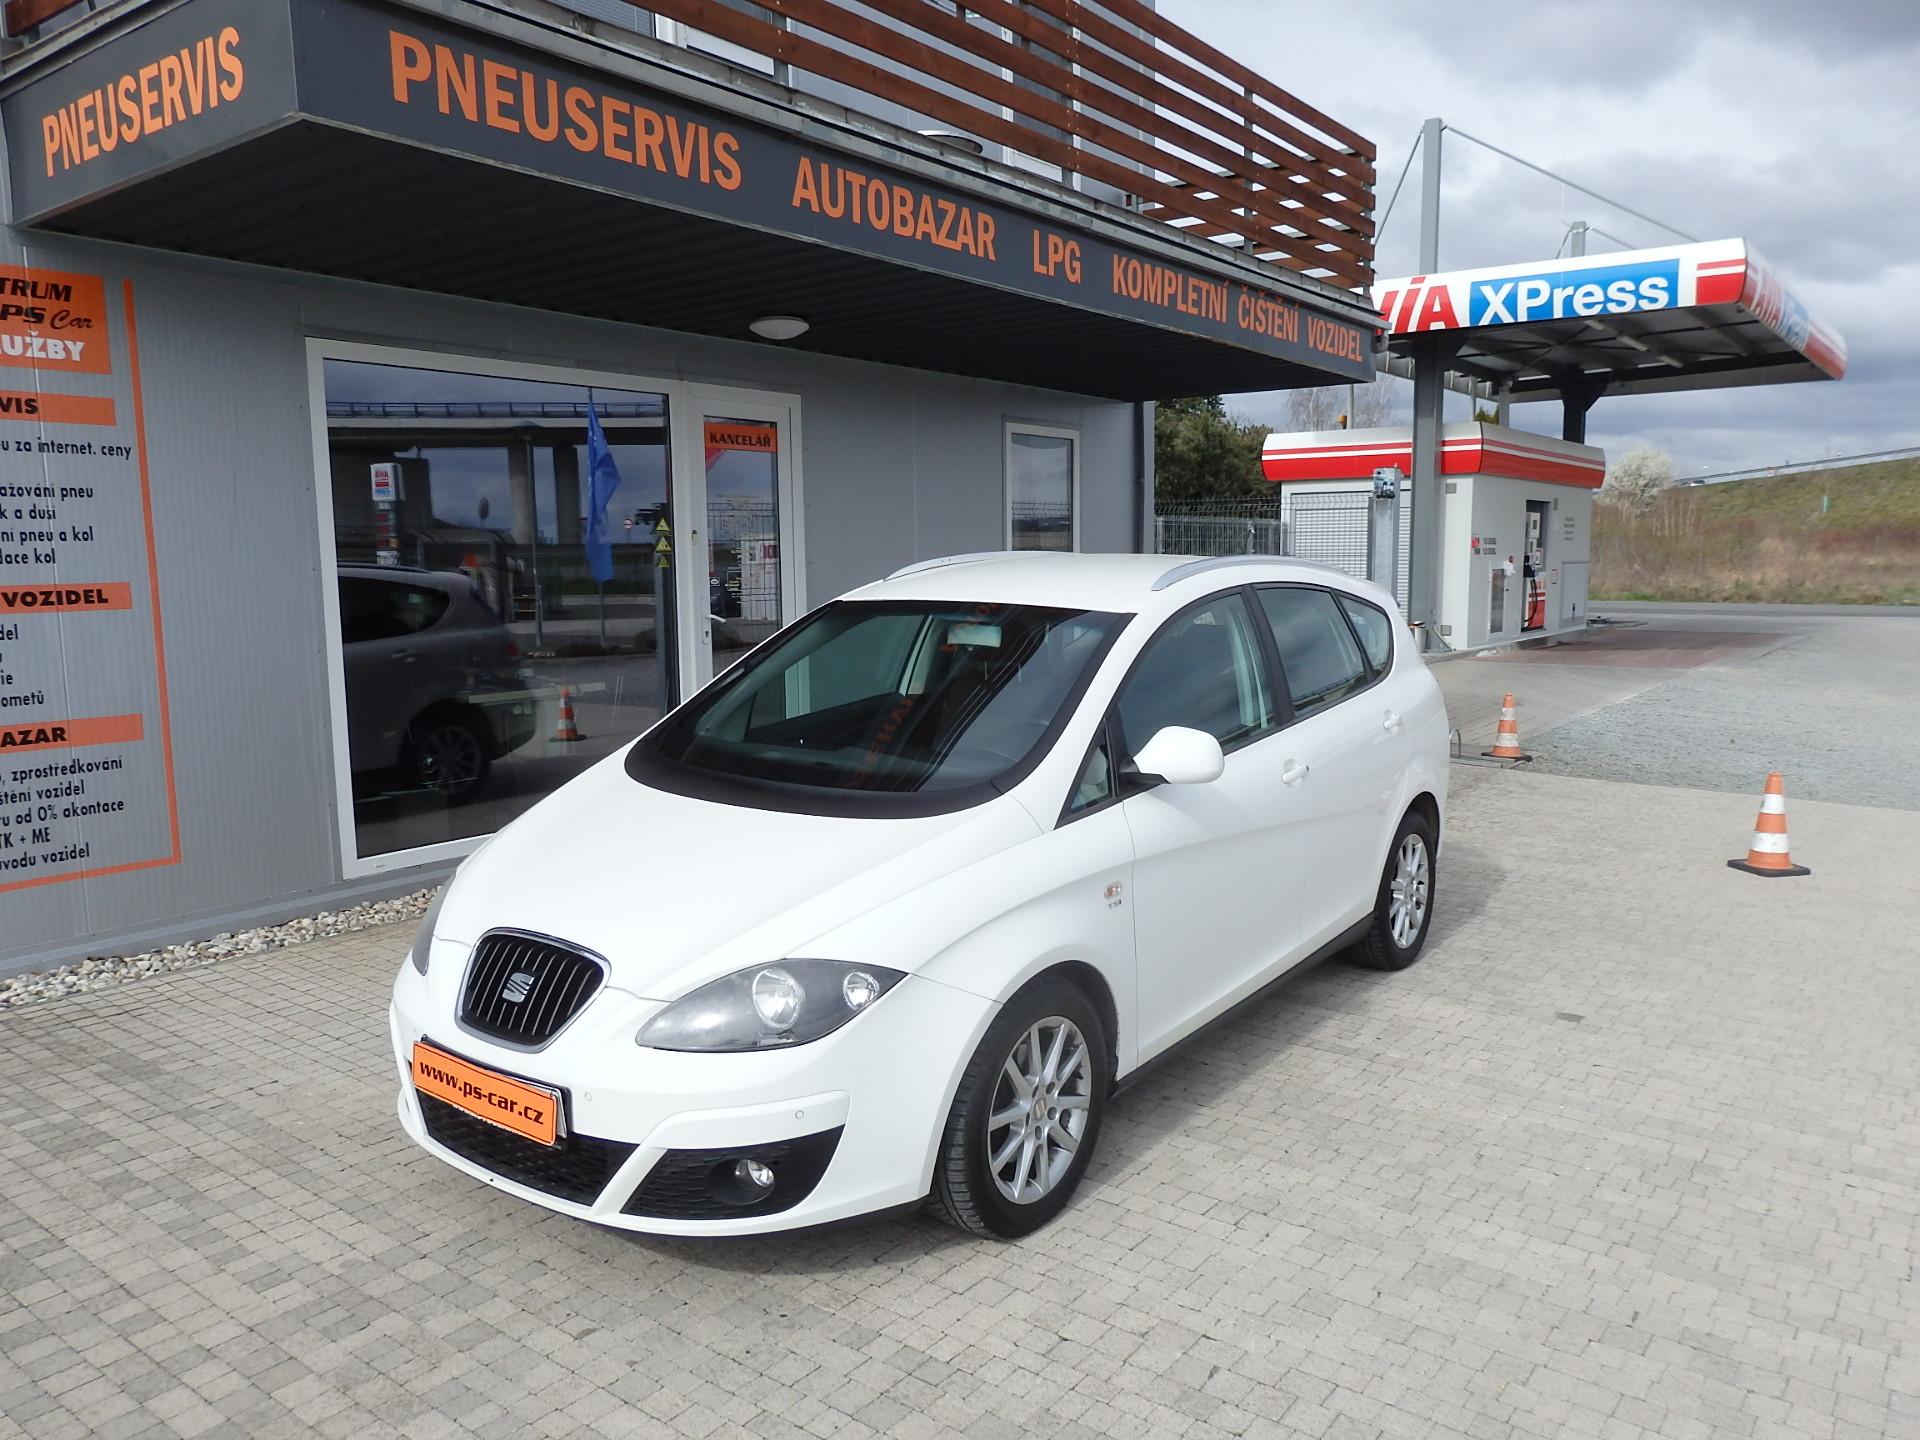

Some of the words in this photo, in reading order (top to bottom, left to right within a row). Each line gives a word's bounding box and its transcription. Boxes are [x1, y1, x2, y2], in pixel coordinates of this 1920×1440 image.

[41, 26, 244, 178] PNEUSERVIS
[388, 29, 742, 191] PNEUSERVIS
[792, 156, 997, 262] AUTOBAZAR
[1032, 229, 1082, 284] LPG
[1112, 254, 1231, 323] KOMPLETNÍ
[1237, 284, 1300, 343] ČIŠTĚNÍ
[1307, 316, 1363, 362] VOZIDEL
[1478, 276, 1669, 326] XPress
[0, 304, 47, 324] PS
[50, 309, 94, 330] Car
[0, 330, 85, 361] UŽBY
[15, 441, 32, 452] za
[37, 436, 97, 455] internet.
[101, 445, 132, 461] ceny
[709, 431, 772, 447] KANCELÁŘ
[60, 487, 93, 501] pneu
[14, 508, 22, 519] a
[20, 531, 53, 546] pneu
[59, 531, 67, 541] a
[72, 525, 93, 541] kol
[33, 547, 55, 564] kol
[1, 589, 109, 608] VOZIDEL
[1, 726, 67, 748] AZAR
[11, 755, 122, 784] zprostředkování
[36, 778, 85, 800] vozidel
[15, 807, 32, 825] od
[37, 804, 58, 822] 0%
[63, 800, 124, 819] akontace
[32, 827, 51, 844] ME
[0, 851, 37, 870] vodu
[41, 841, 90, 863] vozidel
[419, 1061, 545, 1125] www.ps-car.cz
